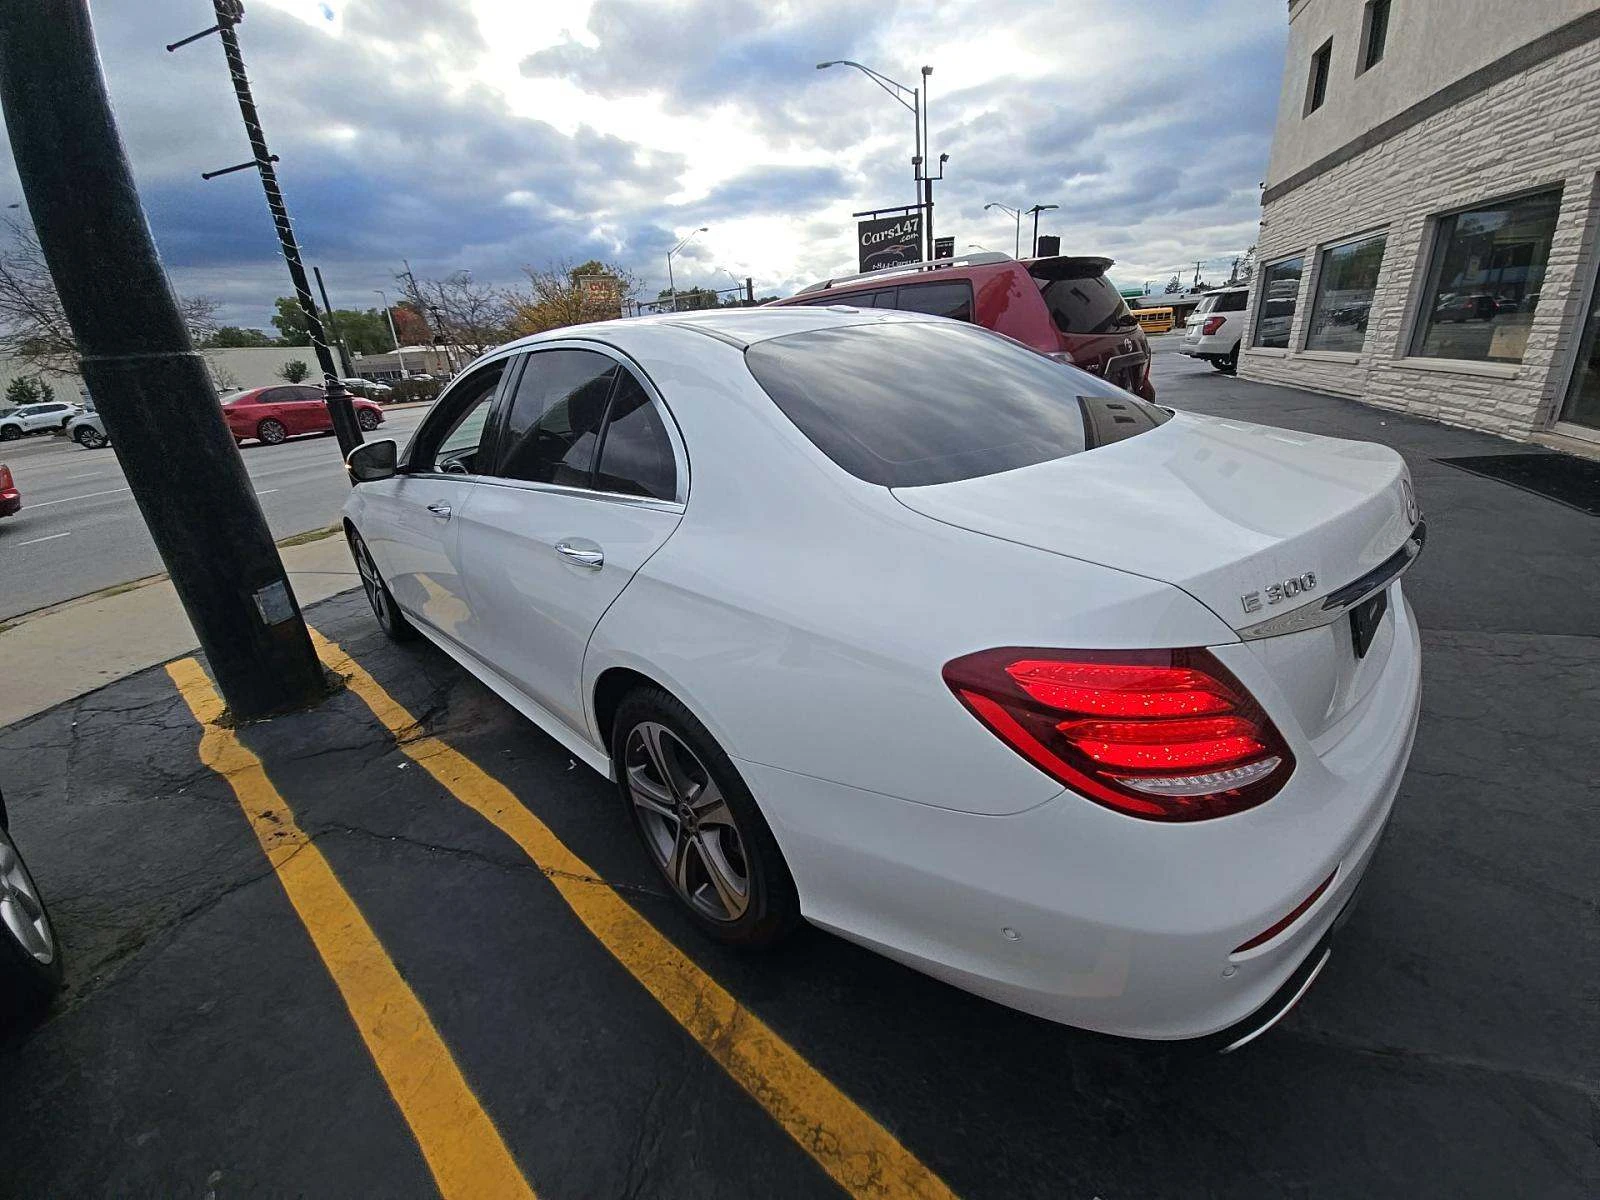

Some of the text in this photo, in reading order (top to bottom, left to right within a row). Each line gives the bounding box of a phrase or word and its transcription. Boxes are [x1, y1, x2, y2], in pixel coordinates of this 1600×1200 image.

[861, 218, 919, 246] Cars147
[900, 232, 919, 243] .com
[1241, 571, 1317, 614] E 300
